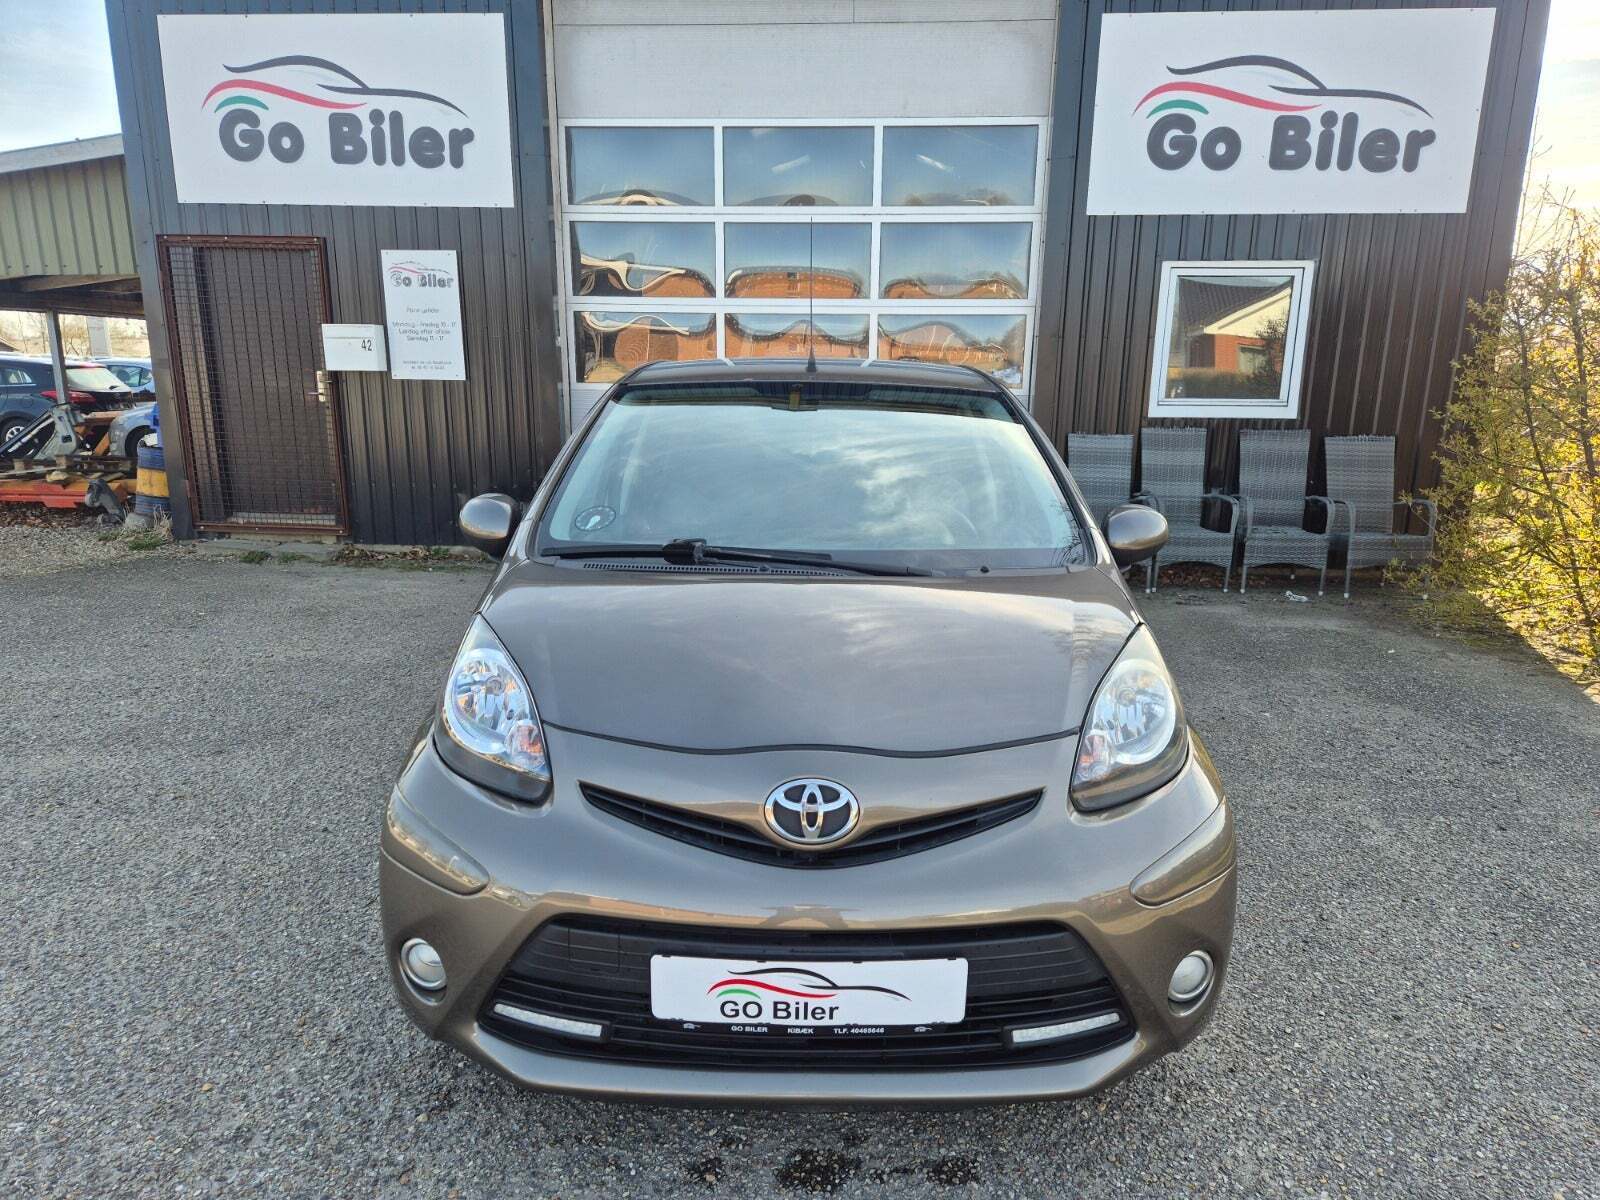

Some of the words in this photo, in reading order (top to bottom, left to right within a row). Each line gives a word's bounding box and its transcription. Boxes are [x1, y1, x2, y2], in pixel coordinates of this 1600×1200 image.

[218, 108, 305, 163] Go
[328, 108, 475, 169] Biler
[1146, 112, 1242, 171] Go
[1268, 110, 1436, 173] Biler
[390, 273, 412, 288] Go
[417, 273, 454, 288] Biler
[361, 339, 373, 351] 42
[720, 1000, 763, 1019] GO
[772, 1000, 840, 1020] Biler
